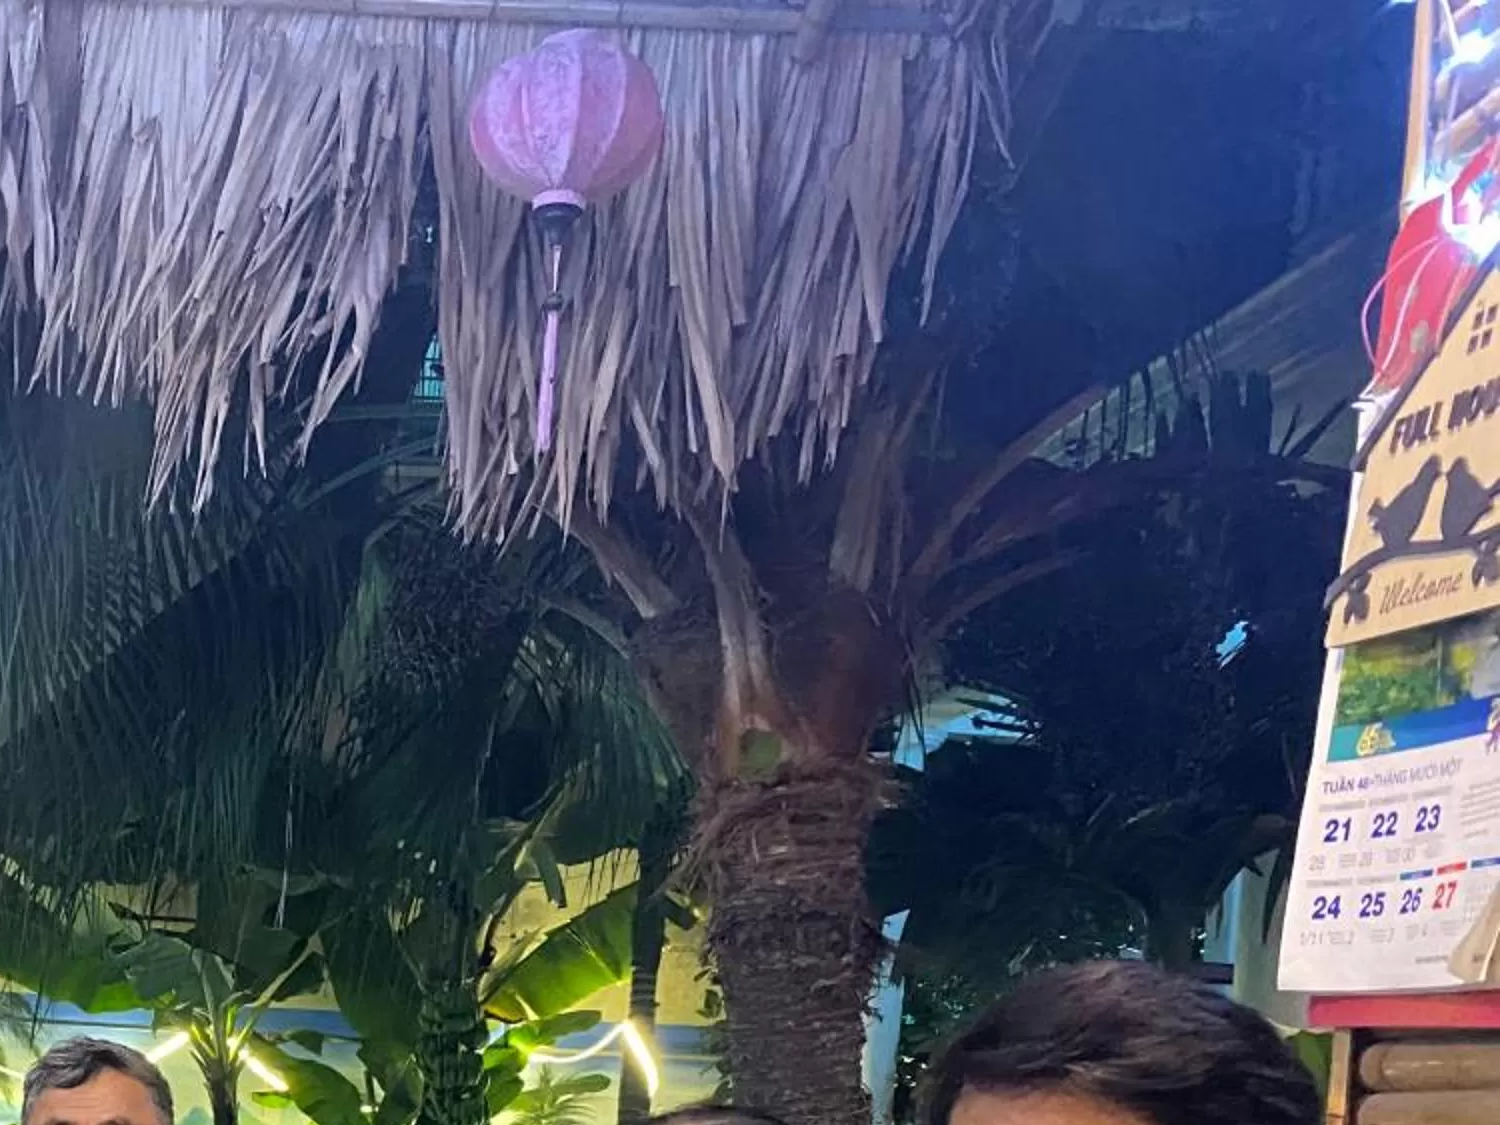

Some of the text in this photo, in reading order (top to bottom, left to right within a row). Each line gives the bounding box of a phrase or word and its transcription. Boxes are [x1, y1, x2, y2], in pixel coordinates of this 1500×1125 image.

[1389, 376, 1500, 454] FULL MOO
[1379, 572, 1463, 615] Welcome
[1323, 817, 1352, 842] 21
[1371, 811, 1398, 838] 22
[1414, 804, 1441, 832] 23
[1311, 880, 1458, 920] 24 25 26 27
